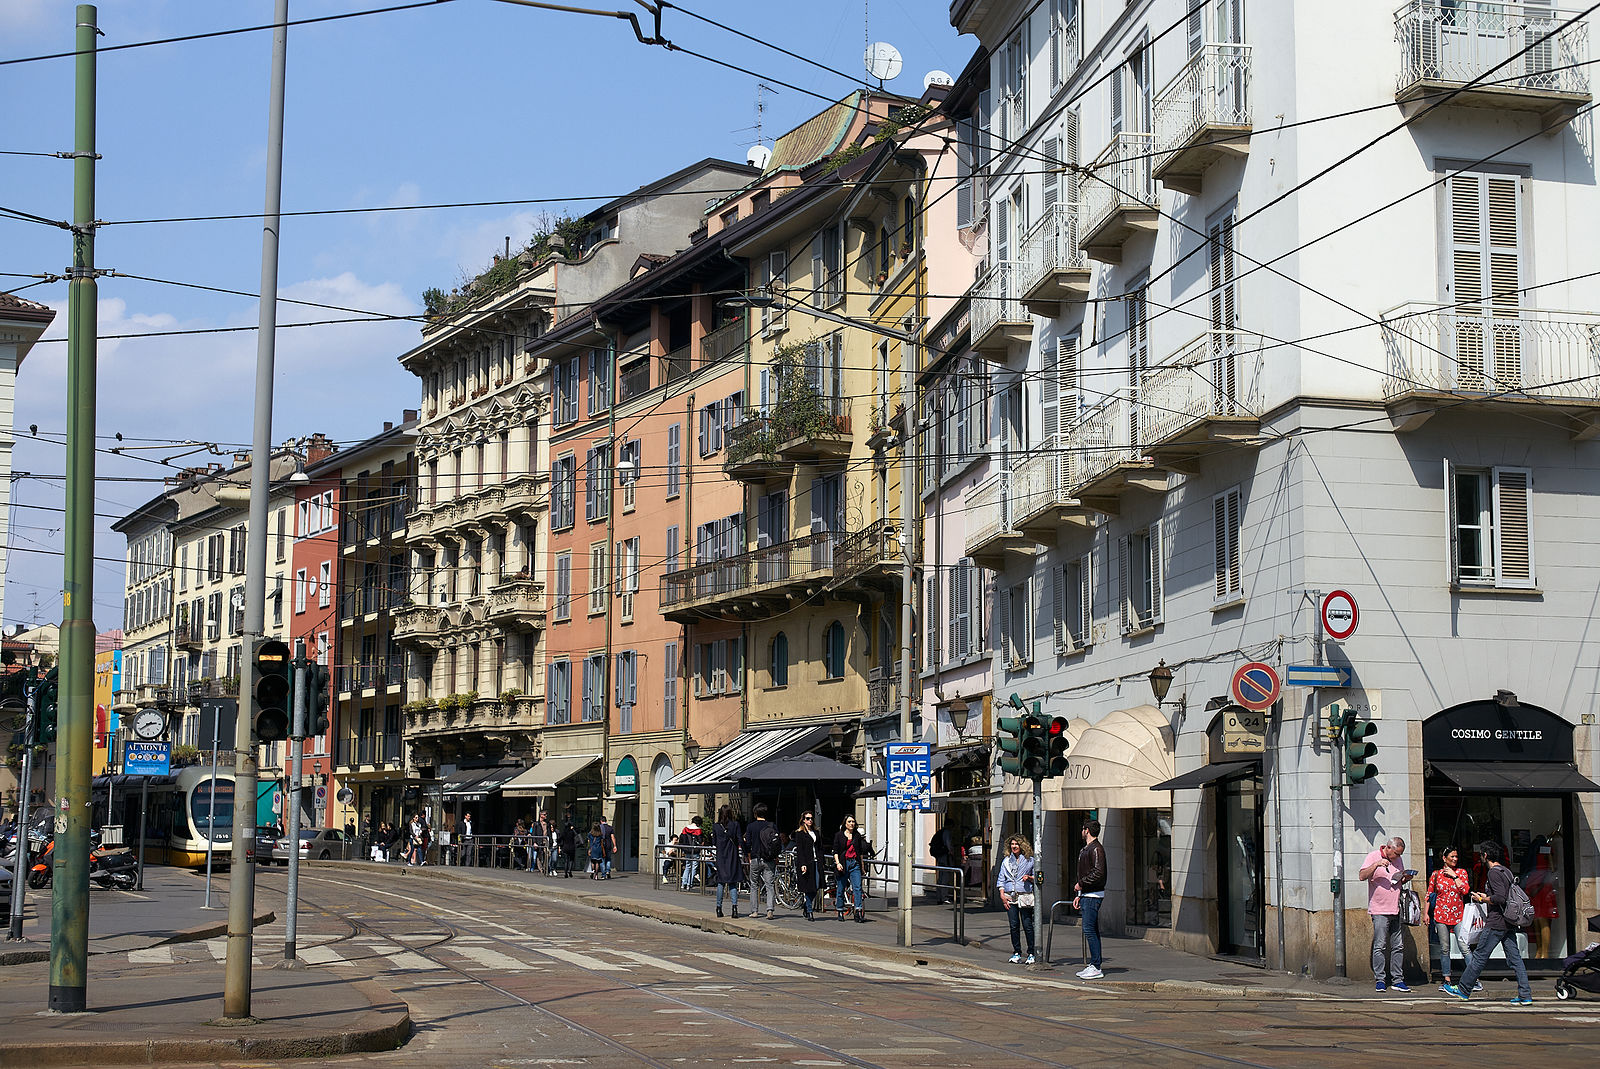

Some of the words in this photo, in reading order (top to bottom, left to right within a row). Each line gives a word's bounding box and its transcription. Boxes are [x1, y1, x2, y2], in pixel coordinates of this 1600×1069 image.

[1451, 728, 1491, 739] COSIMO
[1495, 729, 1543, 740] GENTILE
[128, 743, 139, 751] AL
[140, 743, 168, 752] MONTE
[890, 760, 928, 773] FINE
